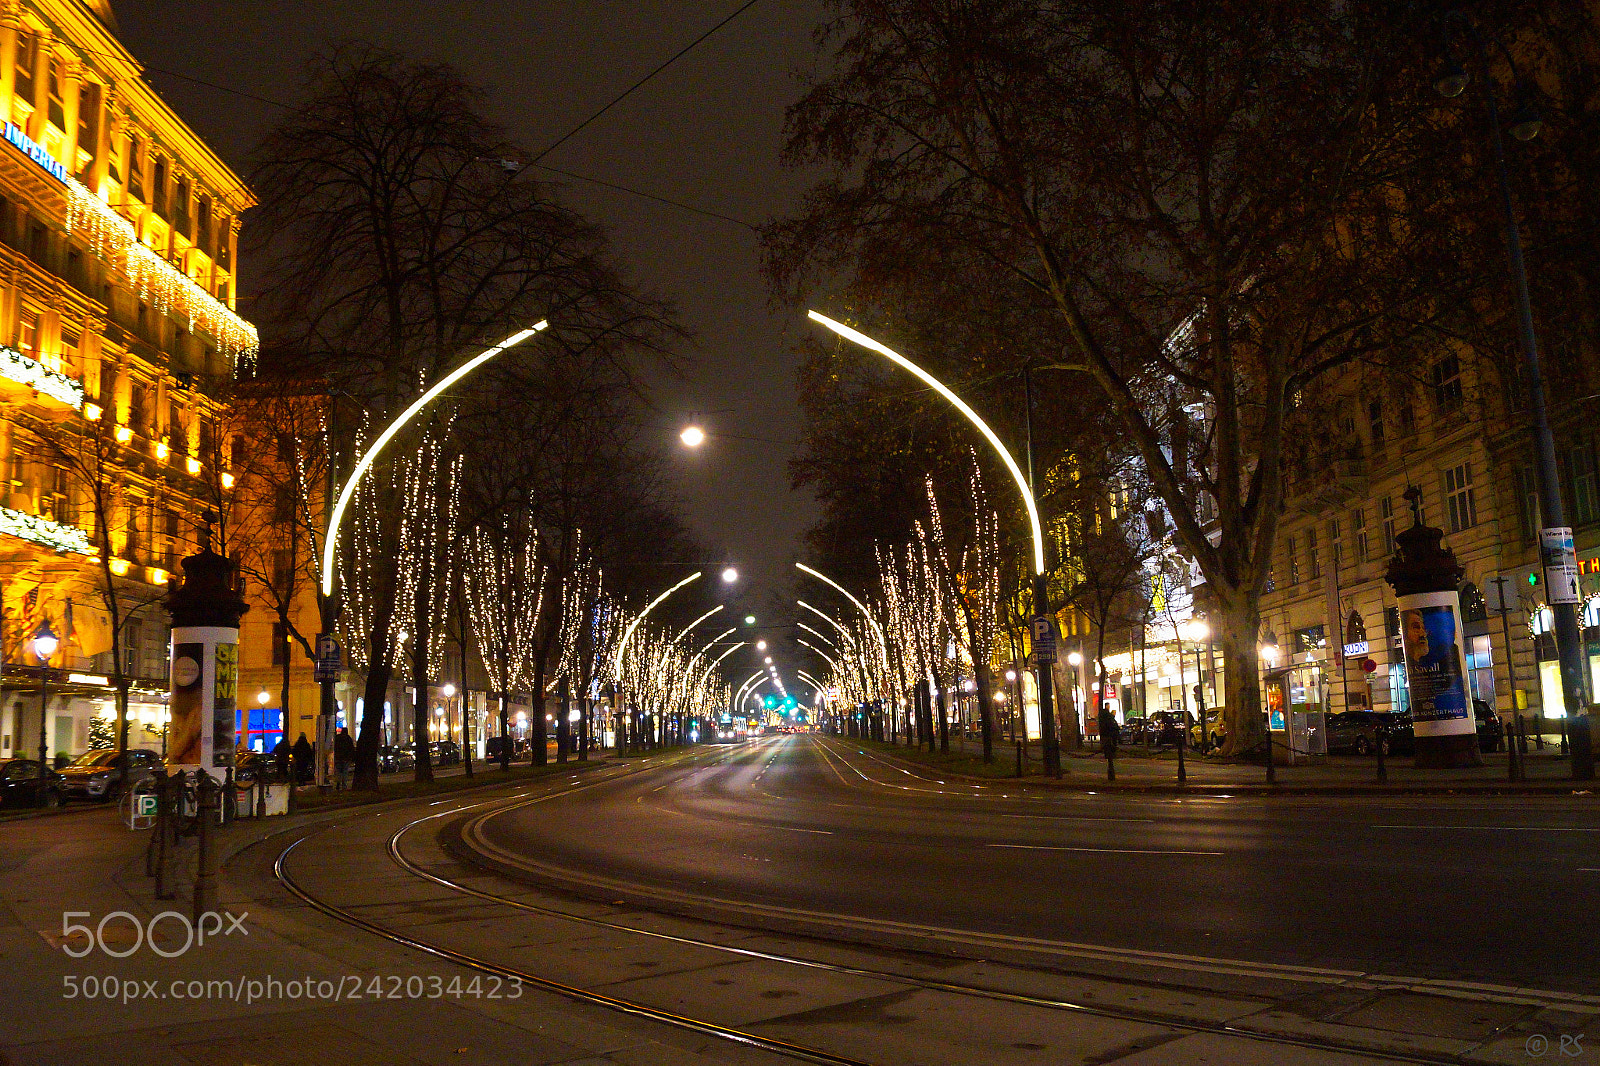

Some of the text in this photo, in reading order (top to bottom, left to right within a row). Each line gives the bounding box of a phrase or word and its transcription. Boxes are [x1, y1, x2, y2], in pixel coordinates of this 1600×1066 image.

[1034, 621, 1048, 640] P
[321, 640, 335, 659] P
[142, 798, 156, 815] P
